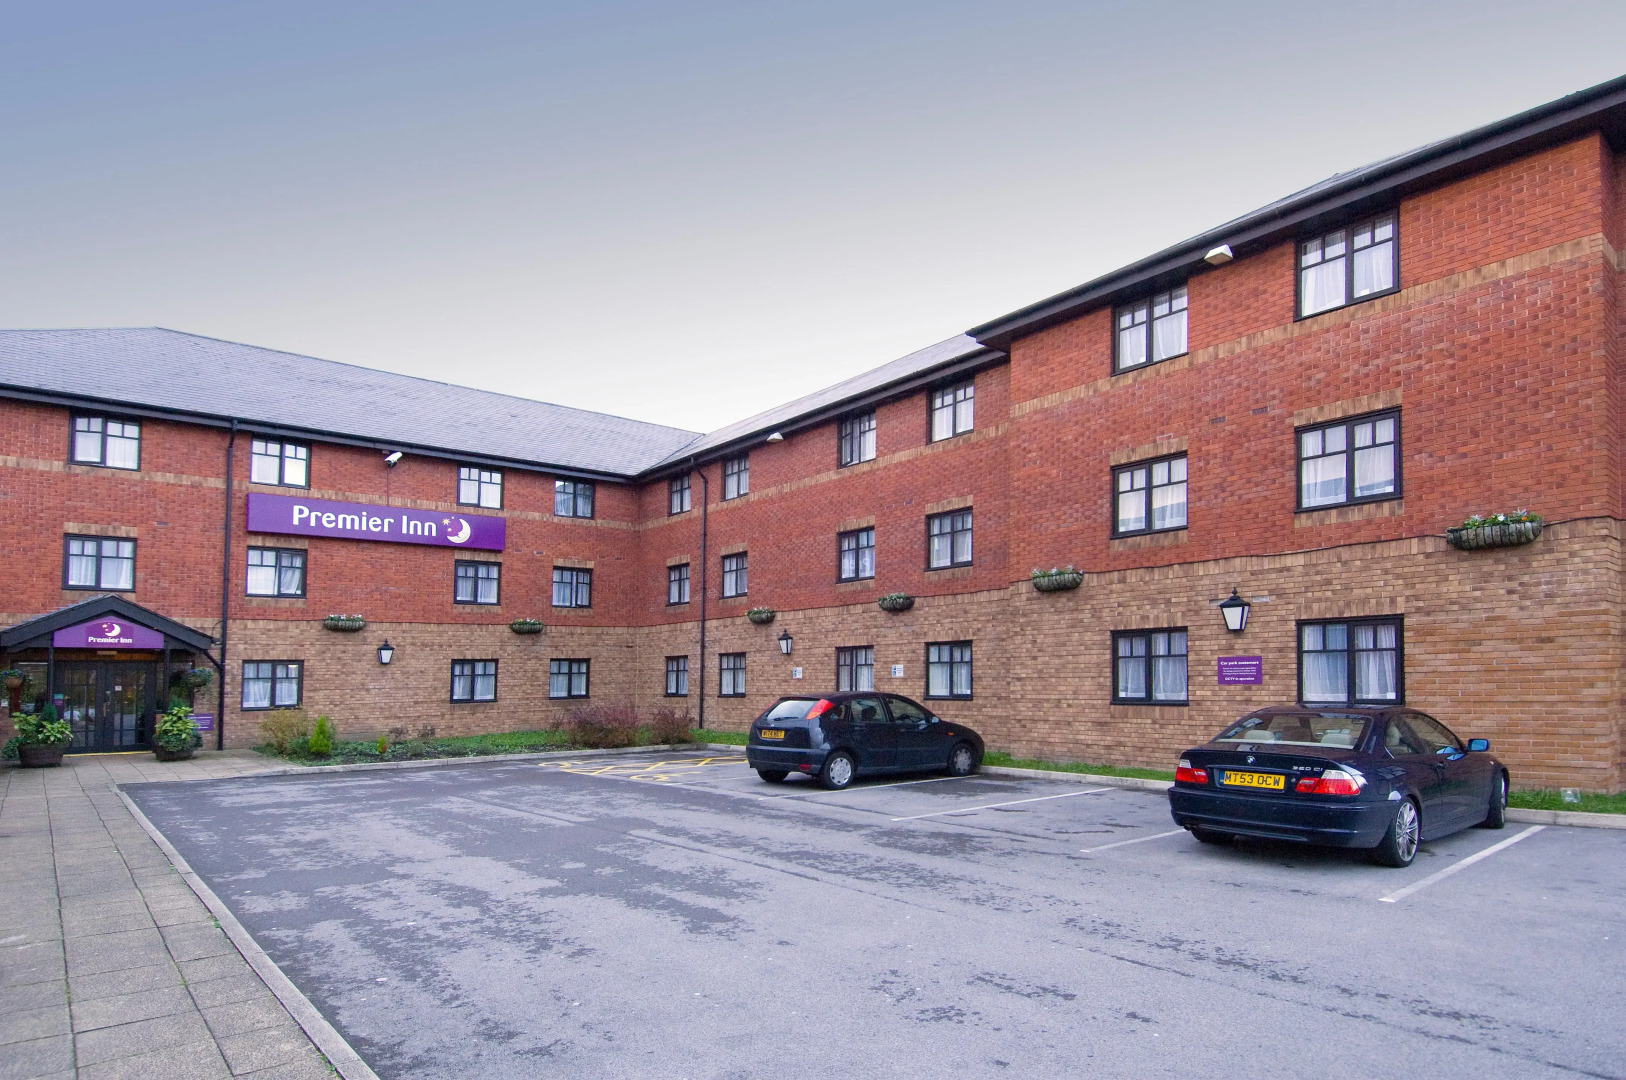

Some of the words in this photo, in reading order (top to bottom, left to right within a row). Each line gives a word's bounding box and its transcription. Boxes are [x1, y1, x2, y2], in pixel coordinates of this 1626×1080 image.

[292, 505, 394, 533] Premier
[402, 515, 437, 537] Inn
[1224, 772, 1254, 784] MT53
[1257, 775, 1281, 787] OCW
